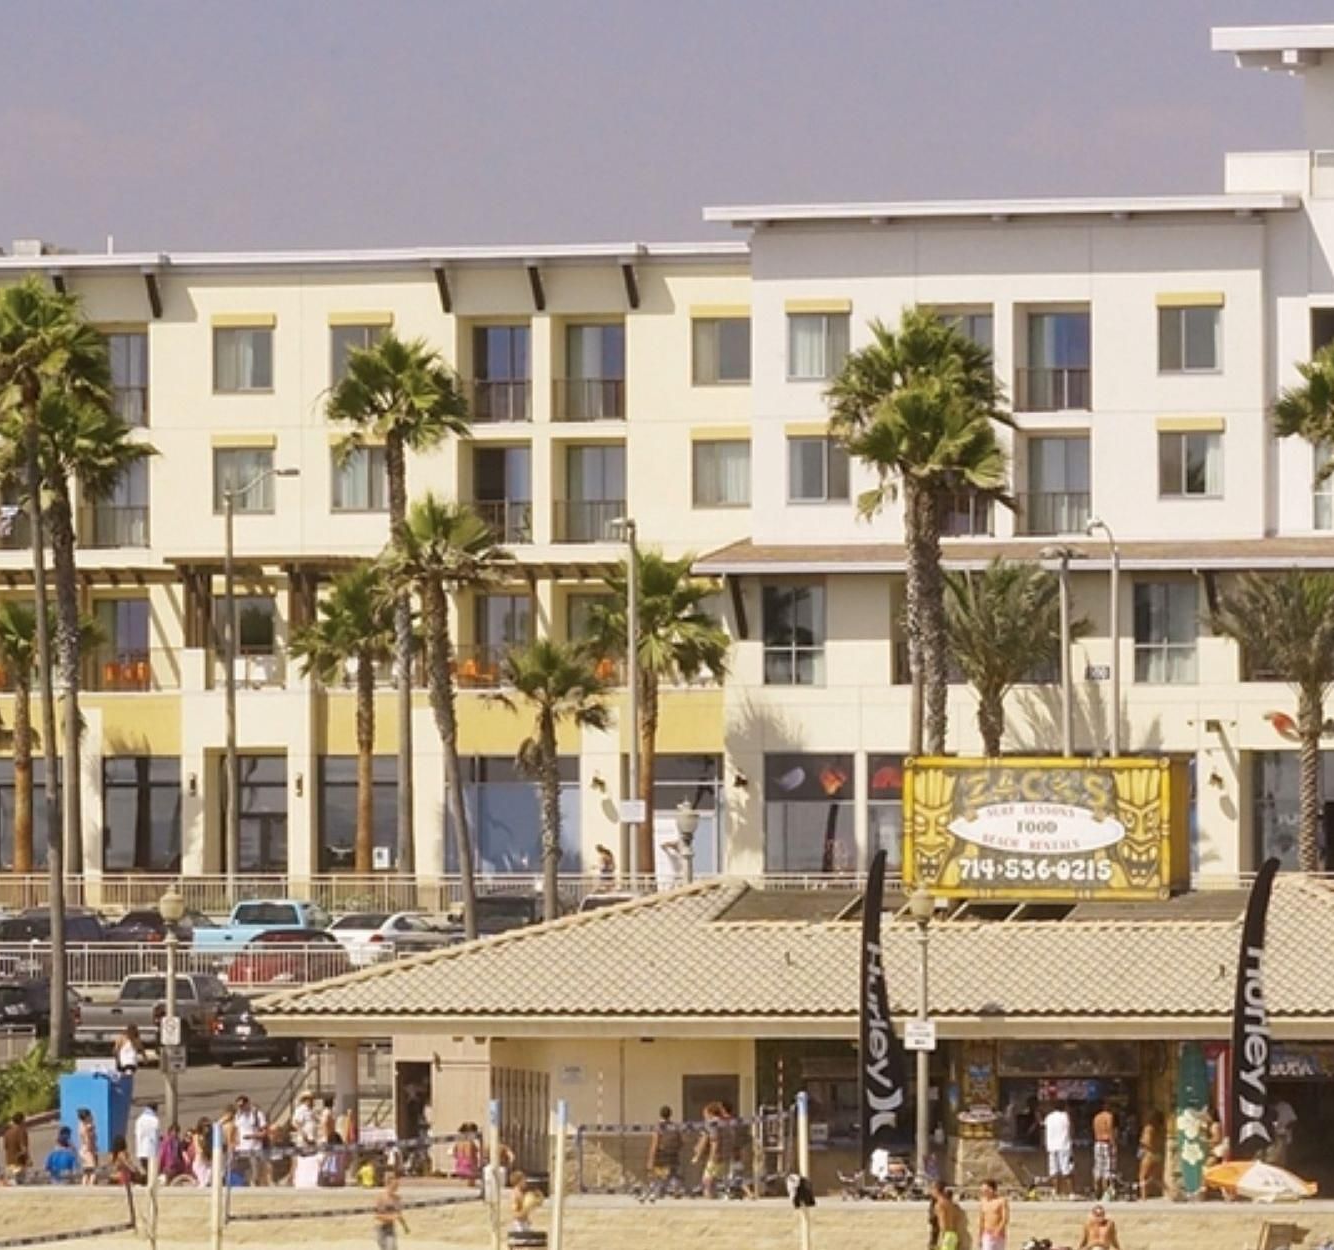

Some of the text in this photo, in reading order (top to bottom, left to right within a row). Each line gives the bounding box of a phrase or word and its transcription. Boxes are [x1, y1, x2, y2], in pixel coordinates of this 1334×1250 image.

[1016, 821, 1058, 834] FOOD
[866, 941, 893, 1088] Hurley
[1240, 946, 1271, 1094] Hurley
